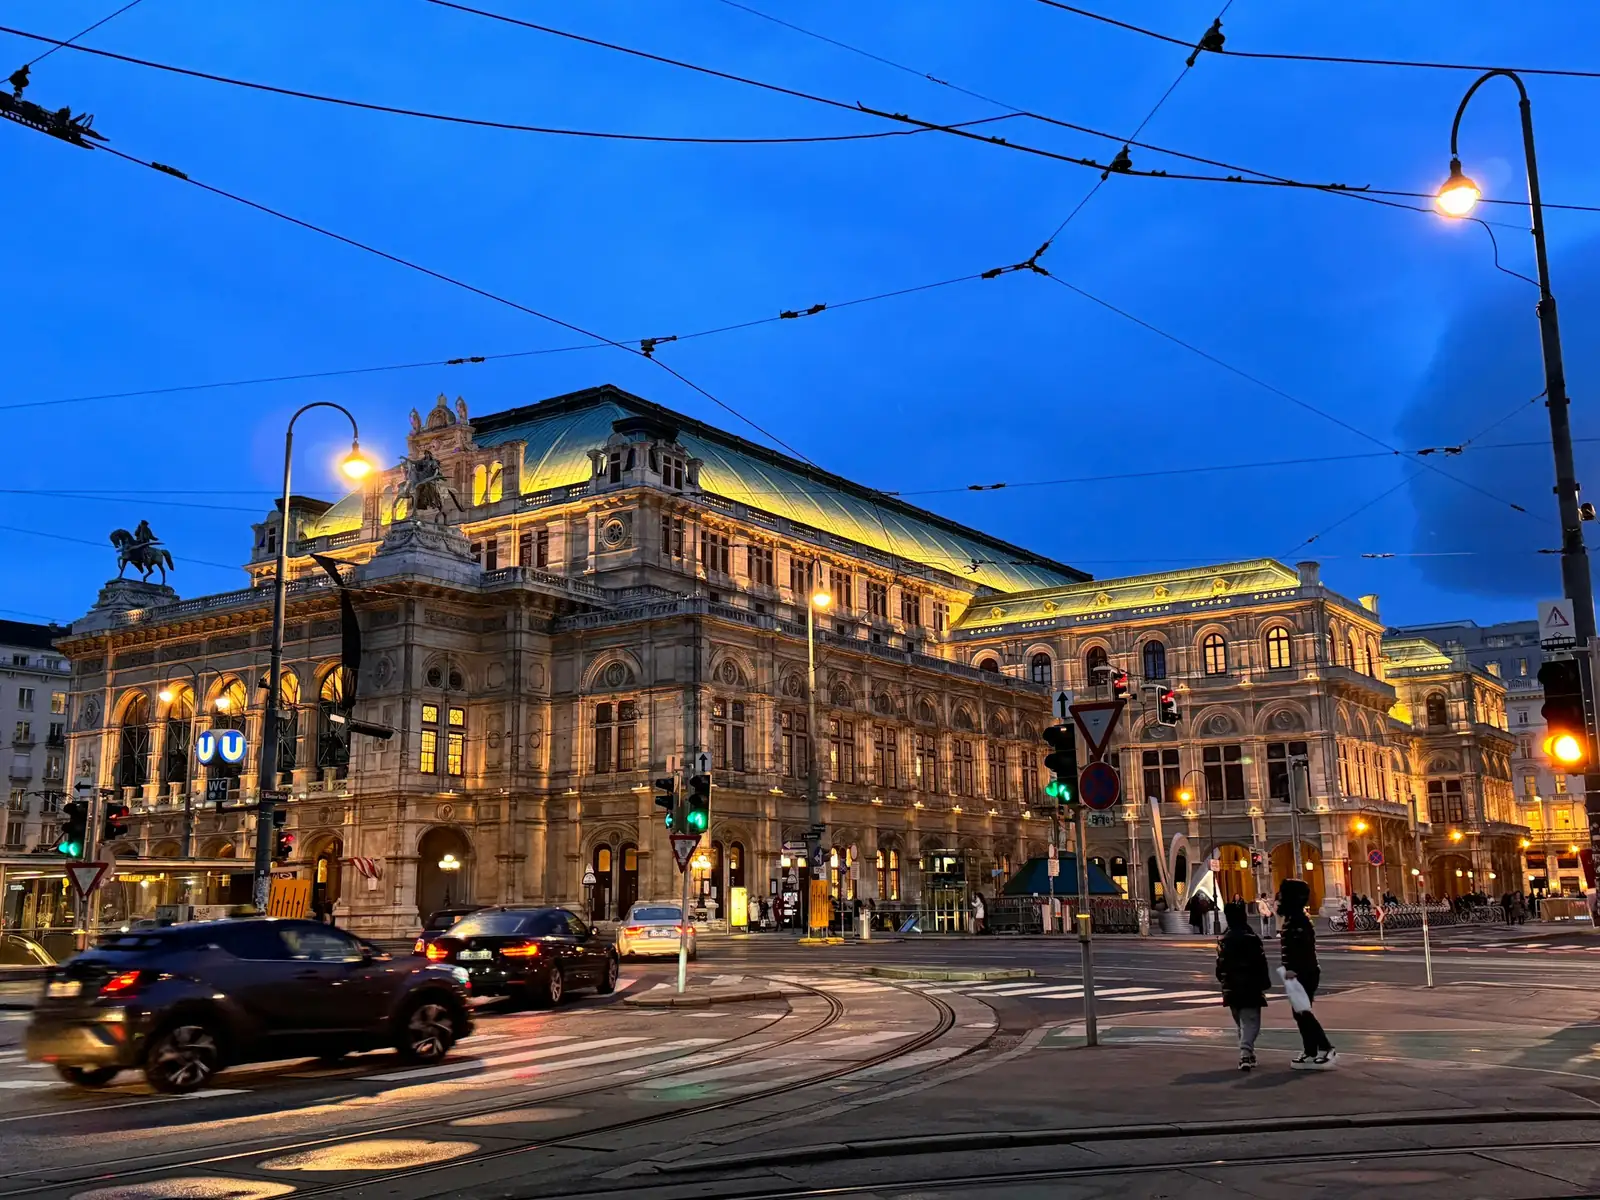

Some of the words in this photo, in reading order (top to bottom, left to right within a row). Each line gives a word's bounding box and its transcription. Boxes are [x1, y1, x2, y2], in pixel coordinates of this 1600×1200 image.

[198, 736, 214, 761] U
[222, 736, 243, 761] U
[208, 780, 227, 791] WC
